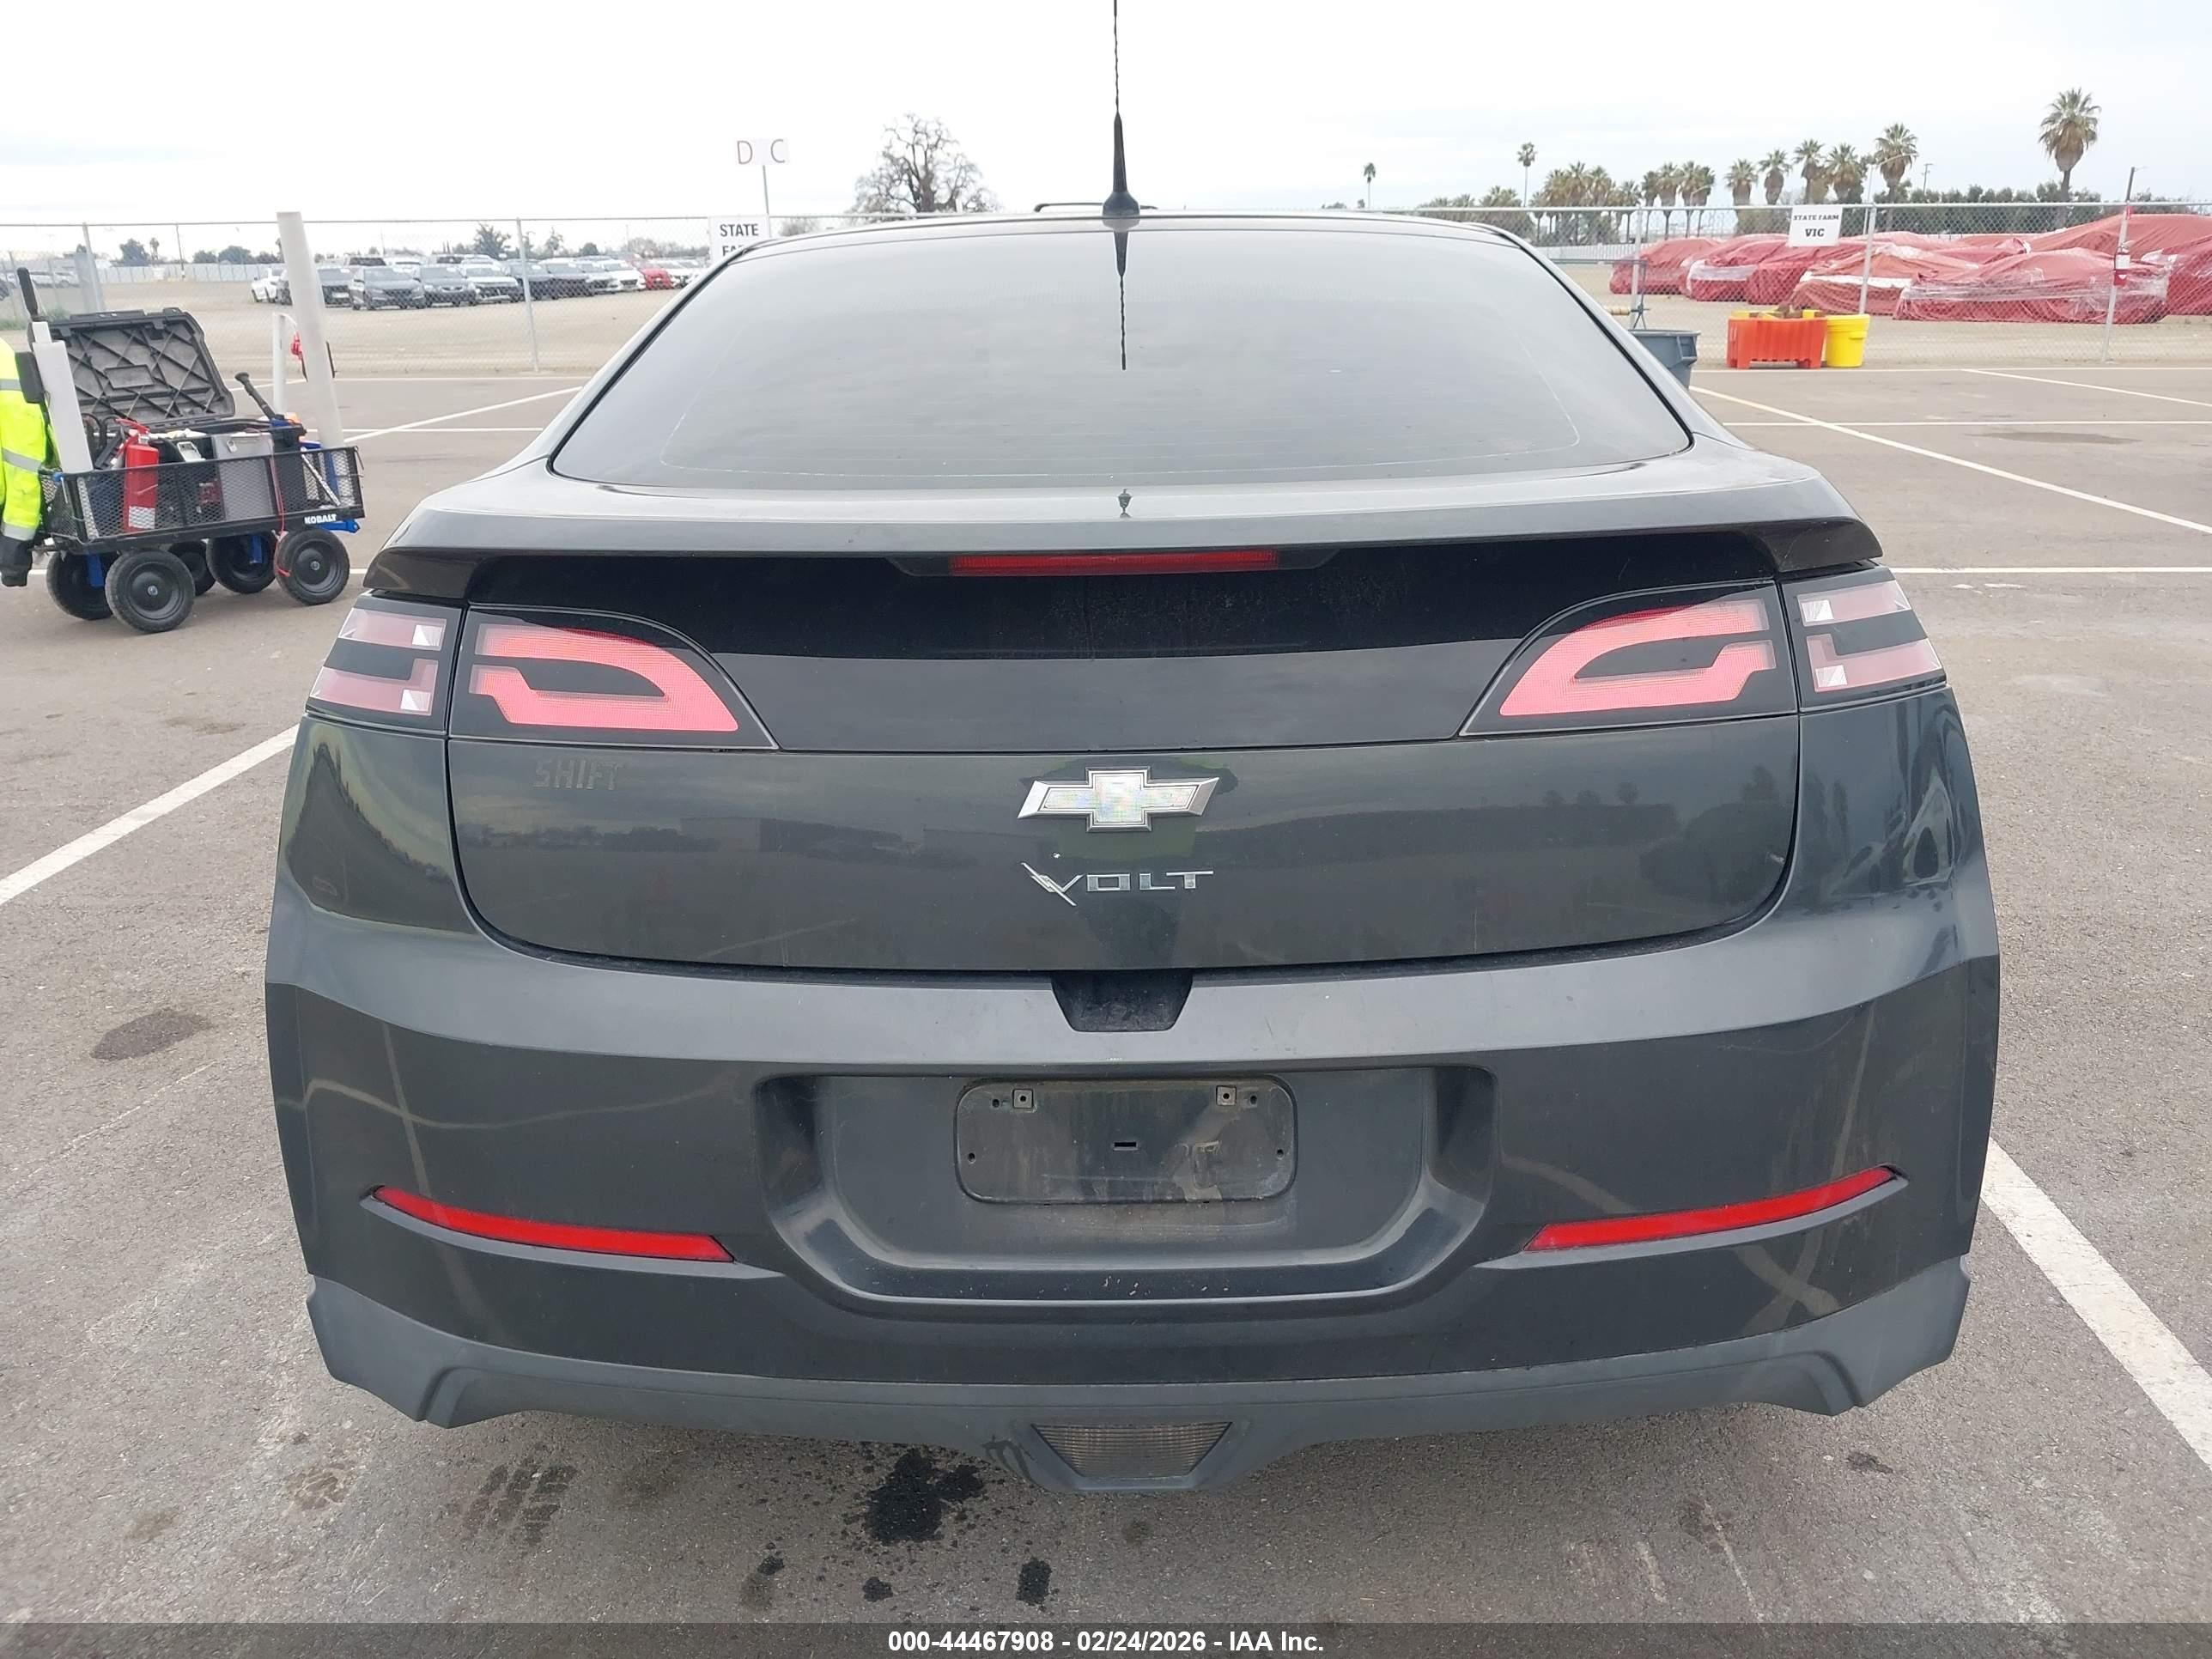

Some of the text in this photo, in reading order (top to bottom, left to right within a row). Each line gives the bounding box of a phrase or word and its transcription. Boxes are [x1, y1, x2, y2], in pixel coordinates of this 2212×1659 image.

[720, 223, 758, 237] STATE
[1805, 228, 1825, 237] VIC
[304, 514, 337, 525] KOBALT
[532, 758, 624, 790] SHIFT
[1020, 861, 1214, 906] VOLT
